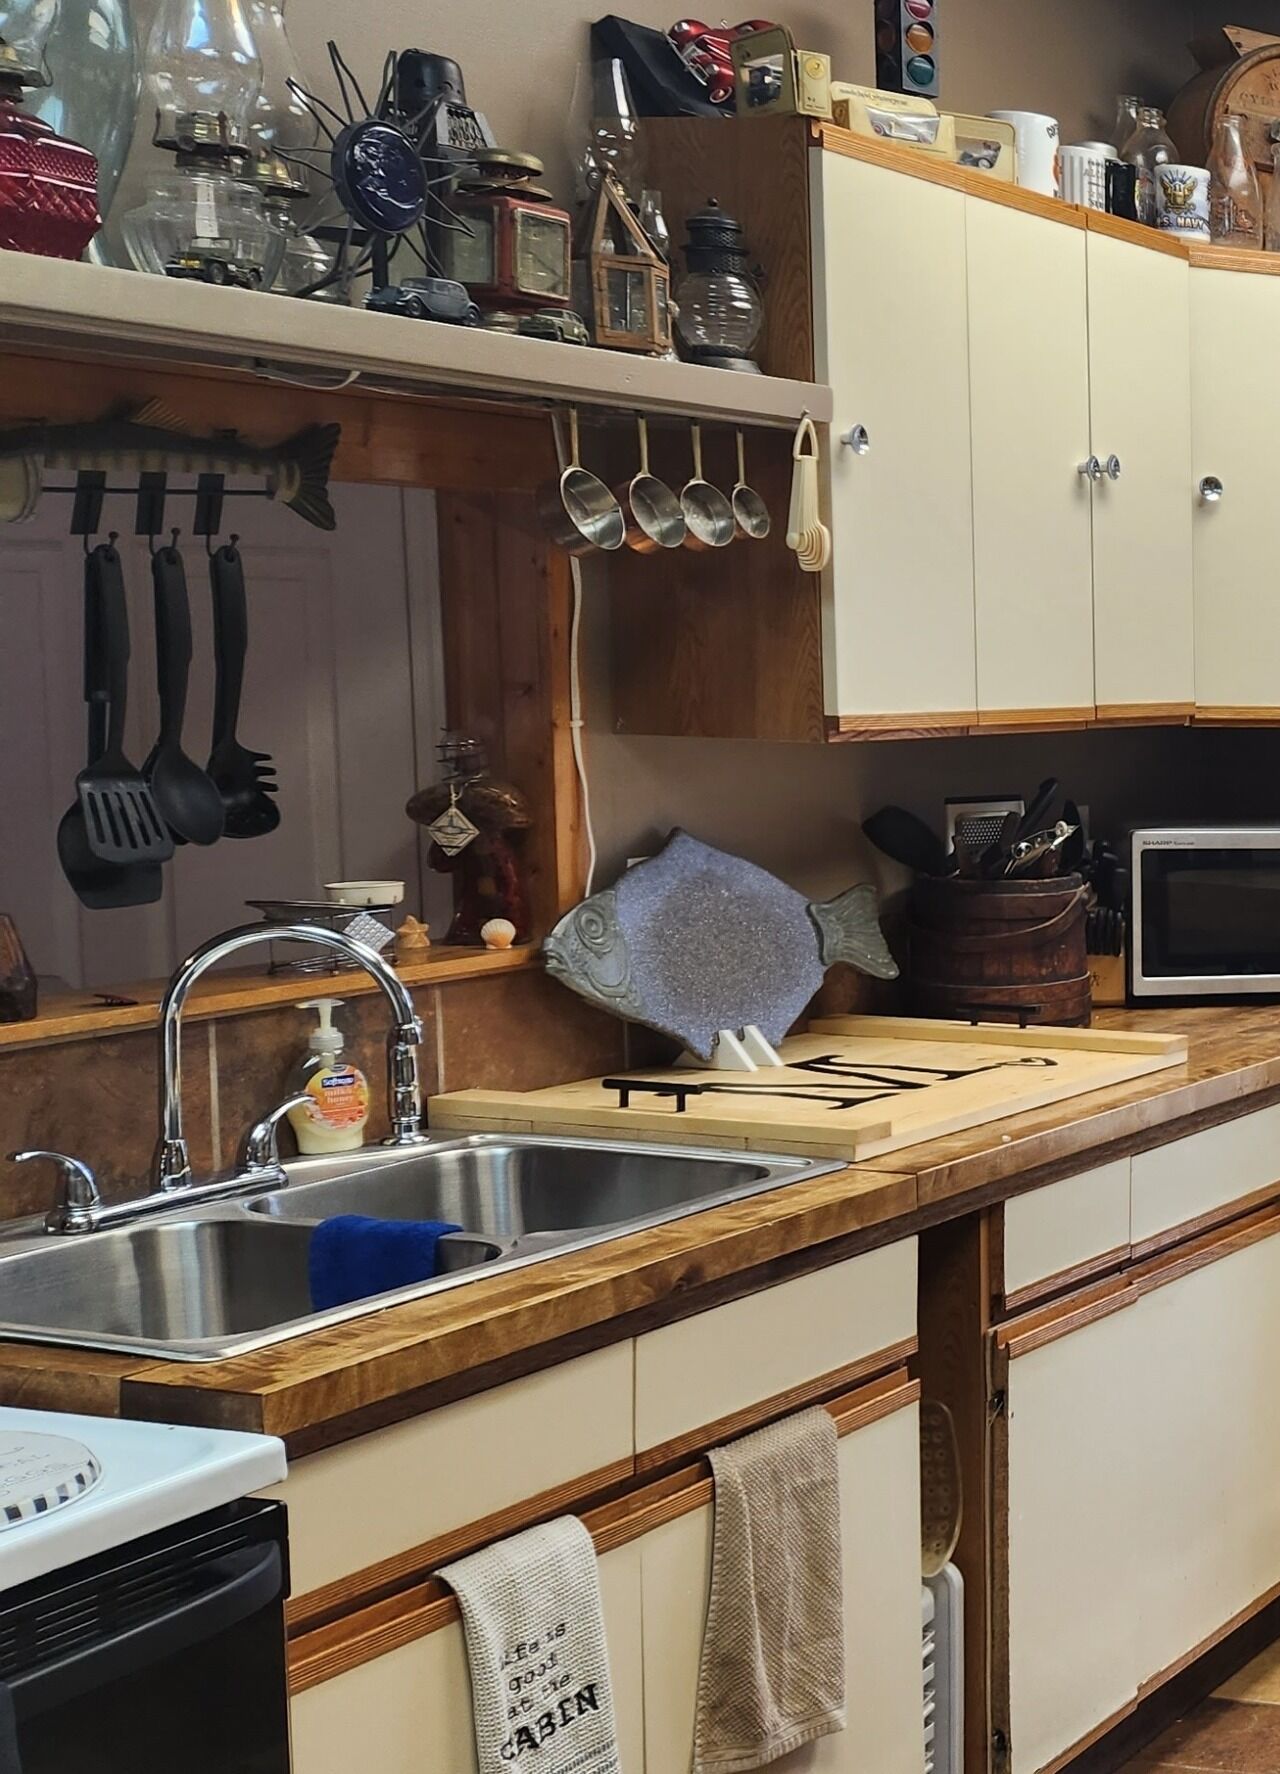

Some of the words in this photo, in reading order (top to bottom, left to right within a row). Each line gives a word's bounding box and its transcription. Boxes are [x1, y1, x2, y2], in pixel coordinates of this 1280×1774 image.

[1176, 215, 1204, 230] NAVY
[508, 1651, 558, 1695] good
[500, 1682, 599, 1760] CABIN
